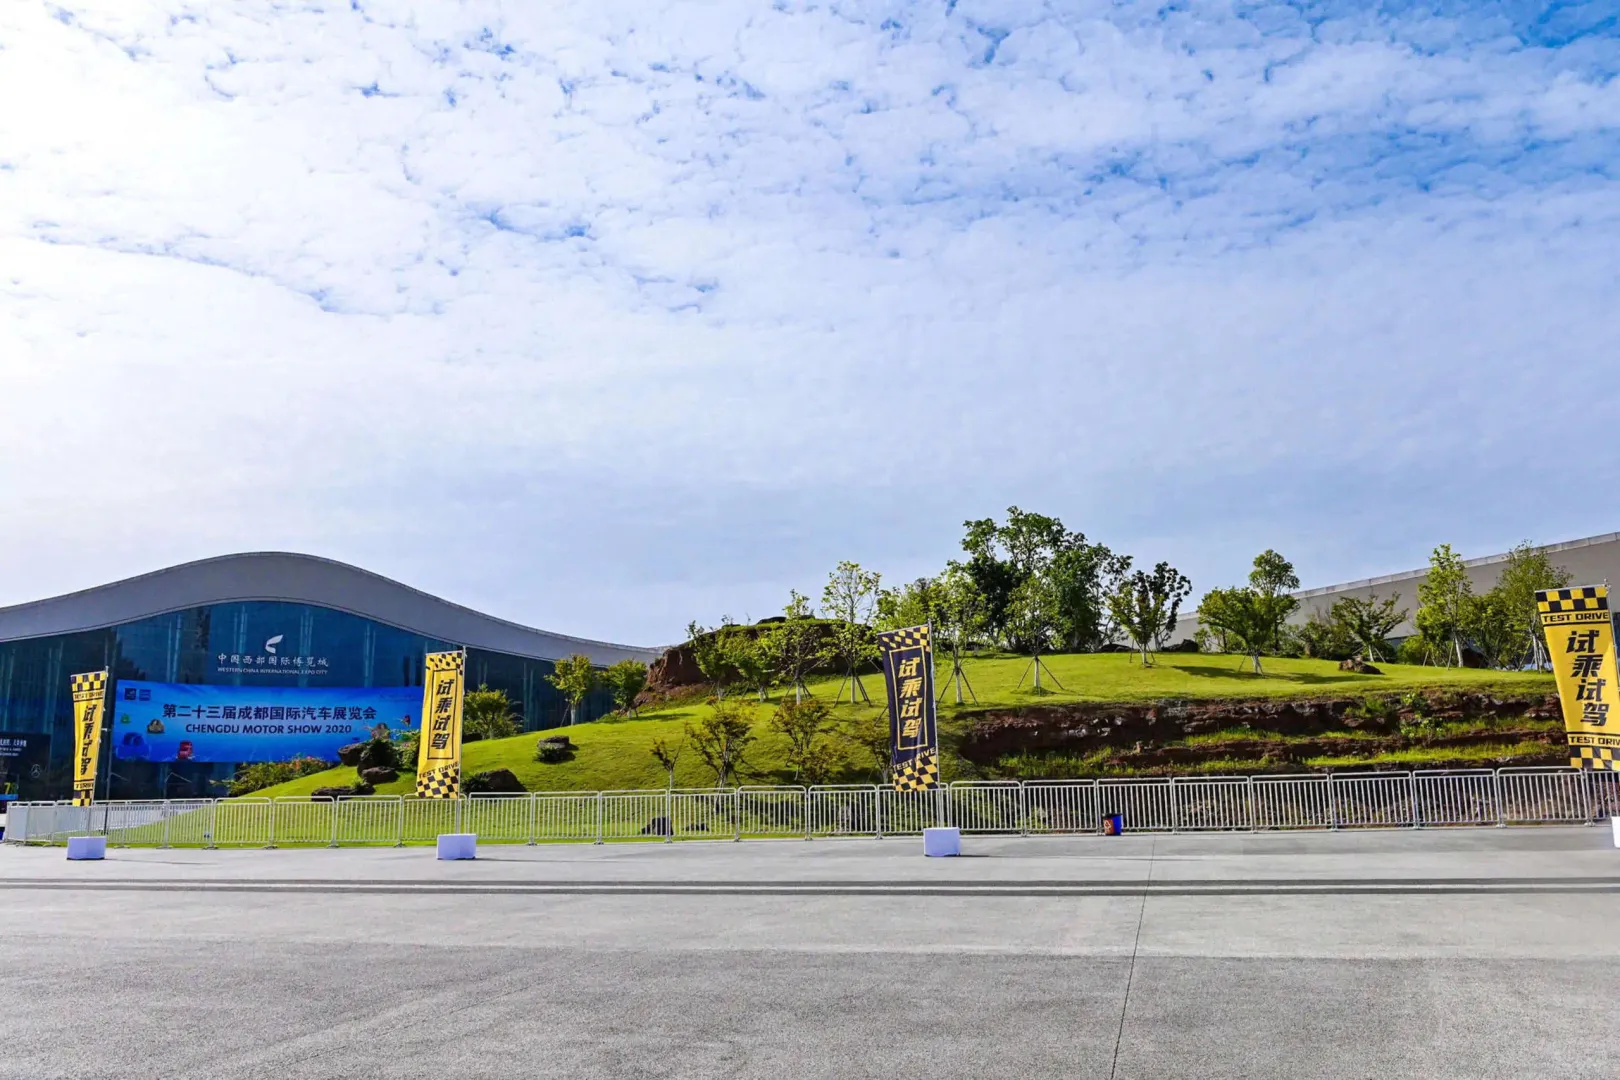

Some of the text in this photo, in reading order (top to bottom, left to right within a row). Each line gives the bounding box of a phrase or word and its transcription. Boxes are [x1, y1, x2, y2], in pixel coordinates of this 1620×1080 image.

[1542, 612, 1609, 622] TEST DRIVE
[1566, 630, 1609, 726] 试乘试驾
[898, 656, 922, 738] 试乘试驾
[162, 704, 376, 720] 第二十三届成都国际汽车展览会
[430, 678, 454, 749] 试乘试驾
[186, 724, 352, 734] CHENGDU MOTOR SHOW 2020
[419, 762, 458, 778] TEST DRIVE
[892, 747, 936, 773] TEST RIVE
